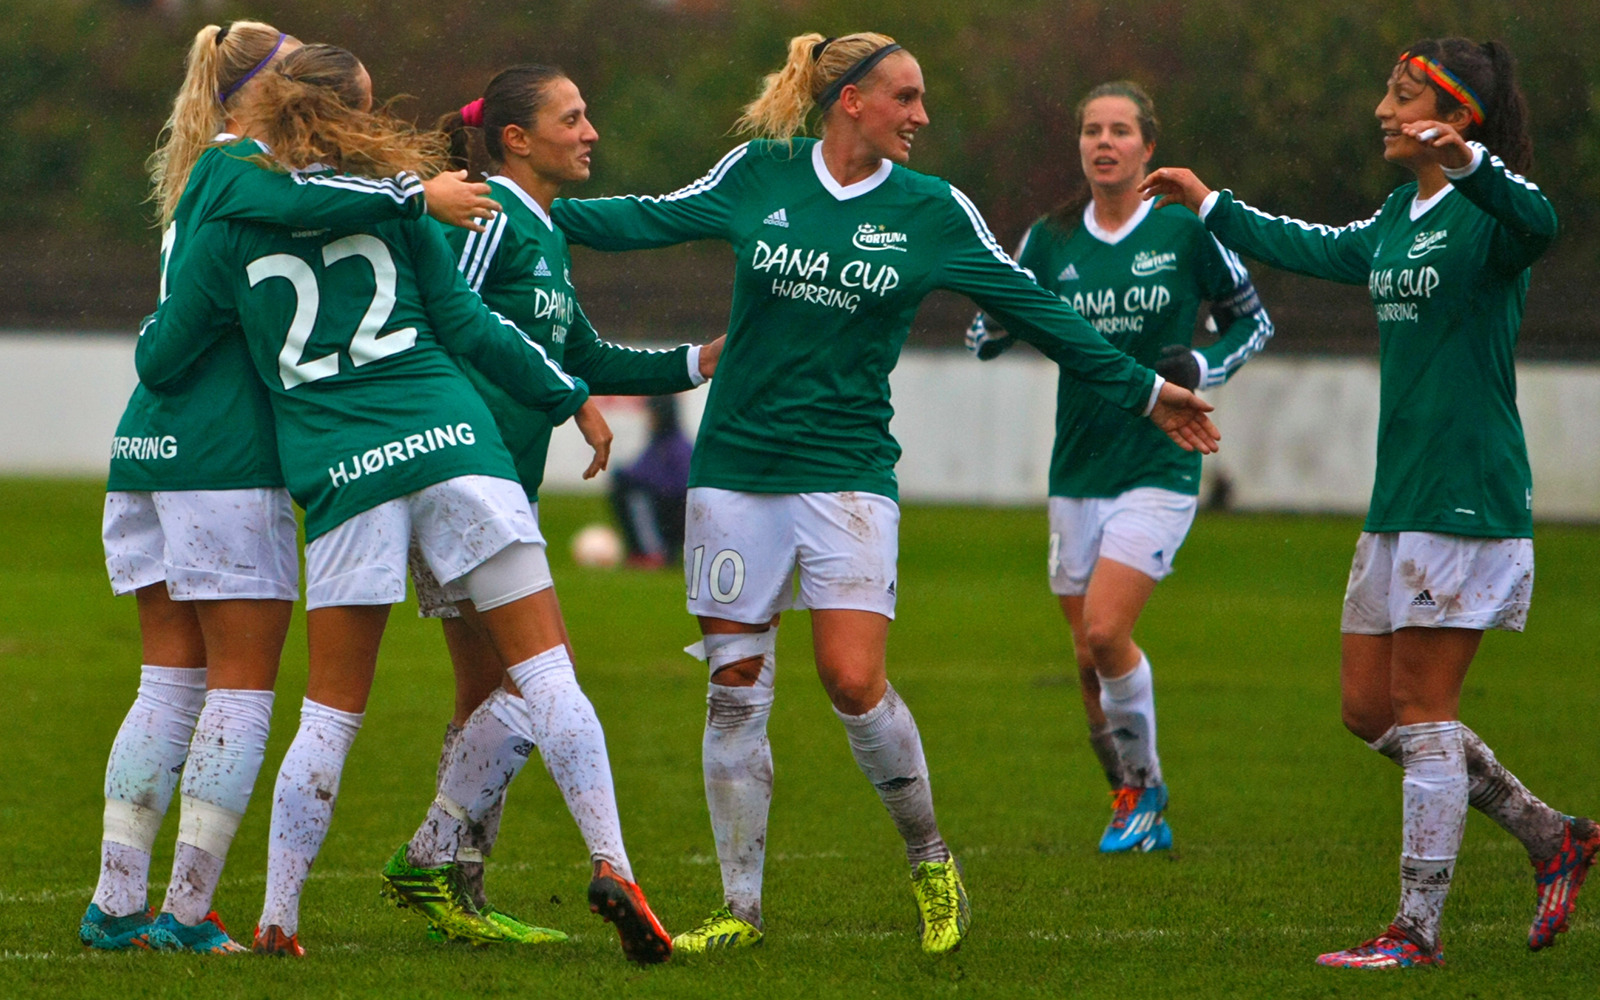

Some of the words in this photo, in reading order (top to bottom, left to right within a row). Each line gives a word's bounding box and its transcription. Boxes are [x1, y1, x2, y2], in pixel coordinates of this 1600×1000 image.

[763, 218, 789, 228] adidas
[859, 232, 908, 244] FORTUNA
[752, 240, 830, 281] DANA
[840, 260, 900, 297] CUP
[1397, 266, 1440, 298] CUP
[246, 234, 418, 390] 22
[772, 278, 861, 314] HJØRRING
[1124, 285, 1171, 314] CUP
[327, 422, 476, 489] HJØRRING
[689, 544, 746, 605] 10
